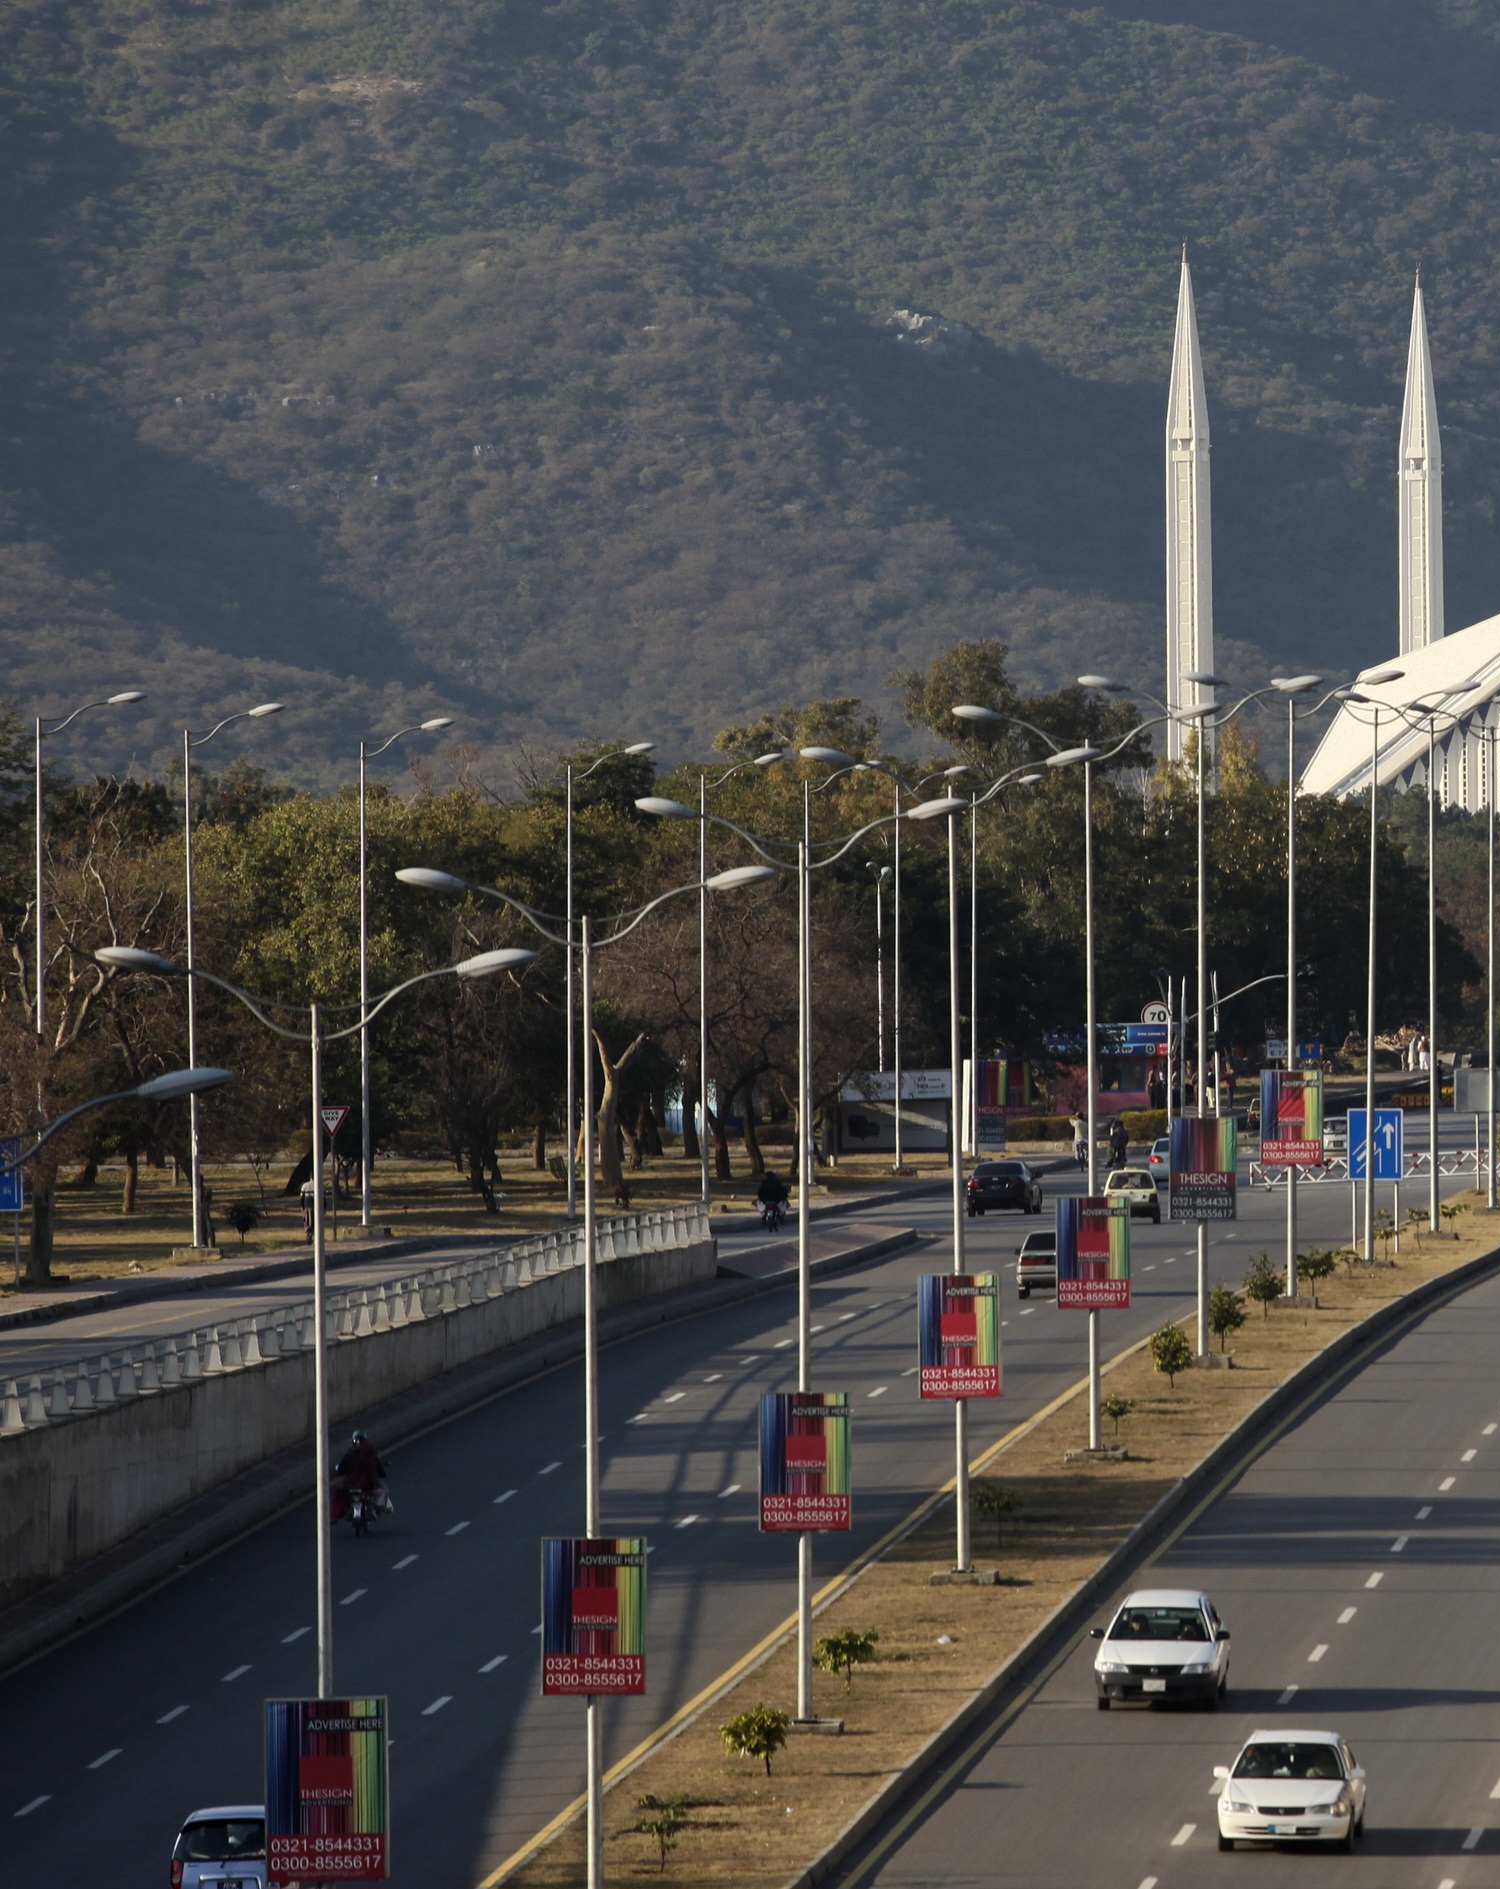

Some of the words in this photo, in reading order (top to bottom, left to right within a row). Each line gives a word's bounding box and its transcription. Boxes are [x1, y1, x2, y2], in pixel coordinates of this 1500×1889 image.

[1149, 1010, 1167, 1022] 70
[1262, 1142, 1319, 1150] 0321-8544331
[1262, 1151, 1320, 1159] 0300-8555617
[1179, 1173, 1227, 1185] THESIGN
[1172, 1197, 1232, 1206] 0321-8544331
[1081, 1208, 1113, 1216] ADVERTISE
[1172, 1208, 1233, 1218] 0300-8555617
[945, 1286, 979, 1296] ADVERTISE
[980, 1287, 996, 1295] HERE
[1059, 1282, 1127, 1291] 0321-8544331
[1059, 1292, 1127, 1302] 0300-8555617
[922, 1368, 996, 1379] 0321-8544331
[922, 1380, 996, 1391] 0300-8555617
[791, 1406, 830, 1416] ADVERTISE
[830, 1407, 849, 1415] HERE
[786, 1460, 826, 1468] THESIGN
[763, 1497, 847, 1509] 0321-8544331
[763, 1510, 848, 1522] 0300-8555617
[579, 1554, 622, 1566] ADVERTISE
[624, 1555, 645, 1565] HERE
[572, 1615, 618, 1624] THESIGN
[572, 1623, 617, 1631] ADVERTISING
[546, 1657, 641, 1671] 0321-8544331
[546, 1673, 642, 1686] 0300-8555617
[307, 1718, 357, 1731] ADVERTISE
[359, 1718, 384, 1730] HERE
[300, 1788, 353, 1799] THESIGN
[300, 1798, 353, 1807] ADVERTISING
[270, 1836, 381, 1853] 0321-8544331
[270, 1854, 382, 1871] 0300-8555617
